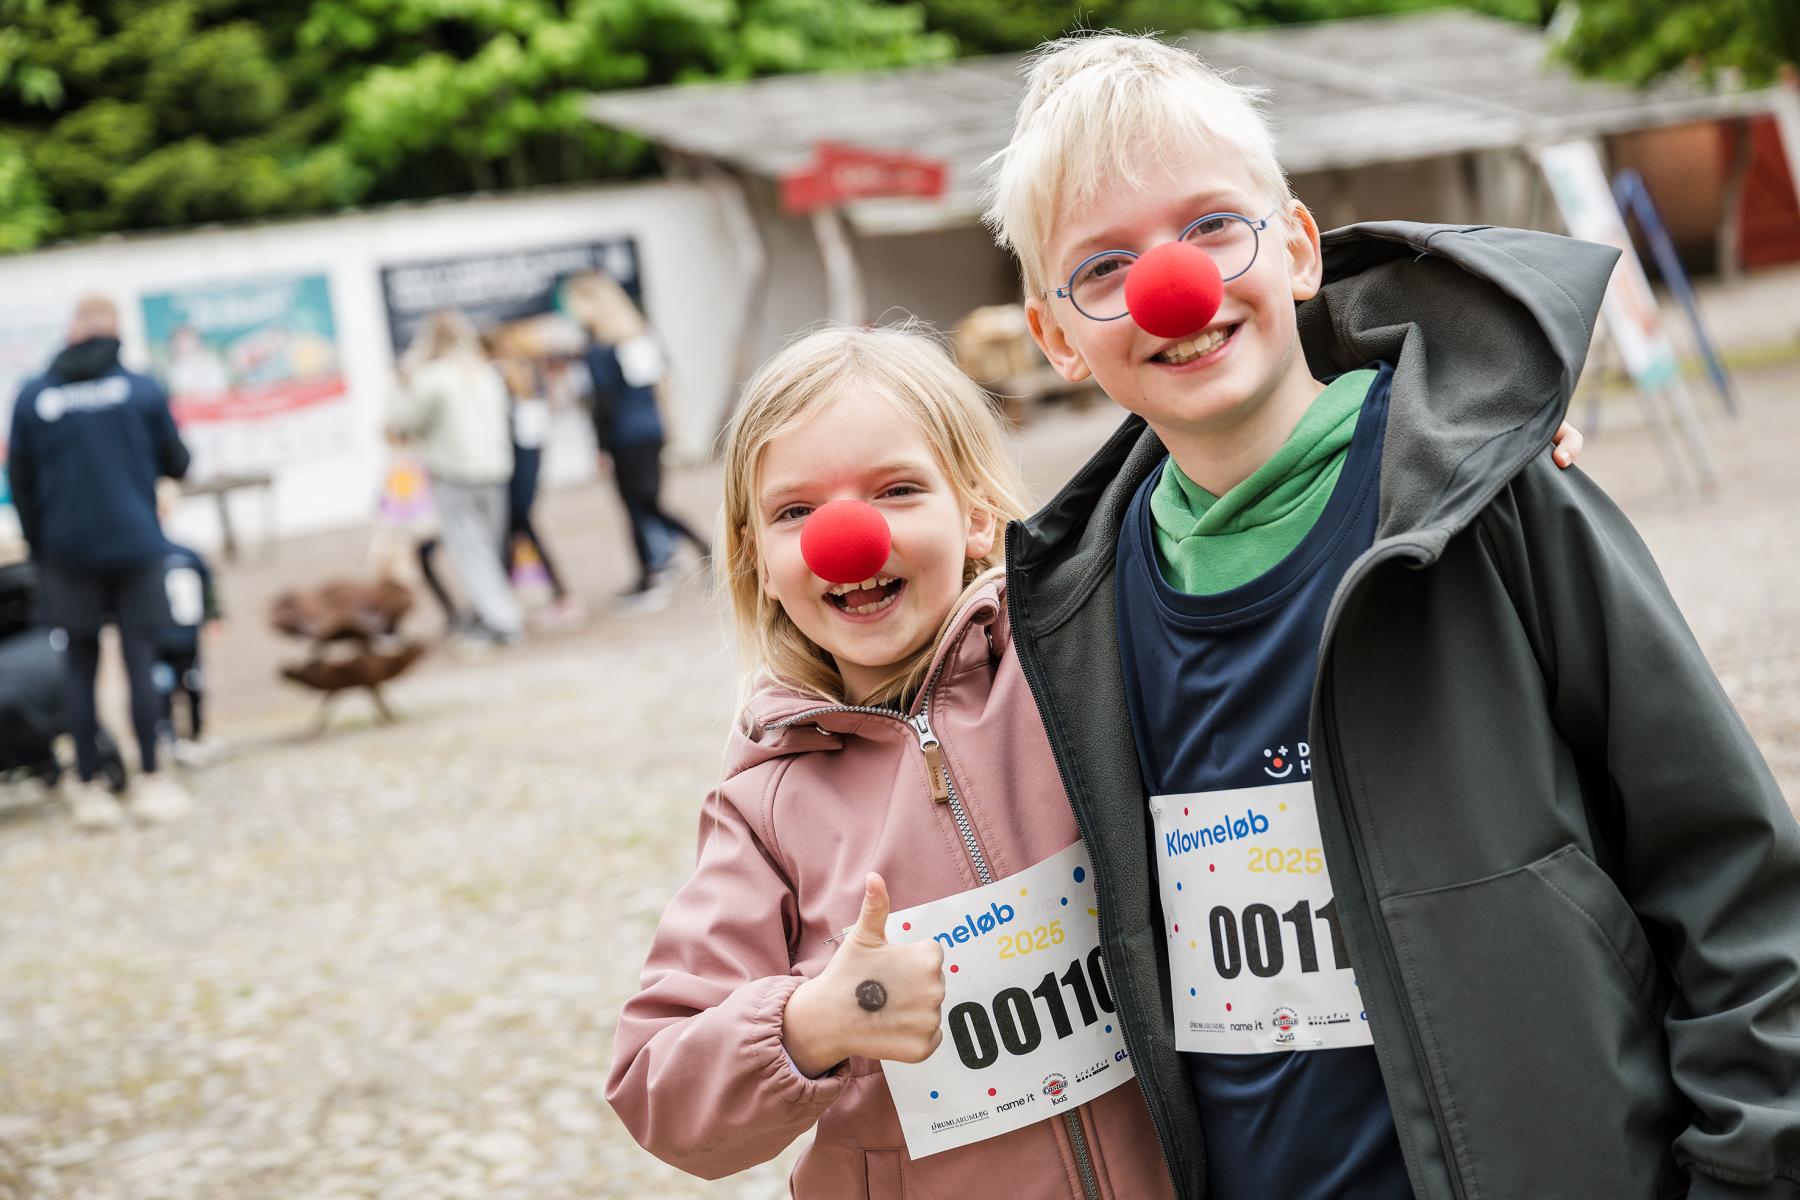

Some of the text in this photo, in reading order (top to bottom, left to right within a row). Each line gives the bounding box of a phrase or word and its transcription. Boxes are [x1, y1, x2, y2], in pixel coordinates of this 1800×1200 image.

[1298, 742, 1311, 757] D
[1165, 809, 1269, 857] Klovneløb
[1247, 847, 1324, 874] 2025
[933, 902, 1015, 948] neløb
[997, 920, 1065, 960] 2025
[1209, 897, 1353, 980] 0011
[1114, 1049, 1128, 1062] GL
[996, 1099, 1025, 1114] name
